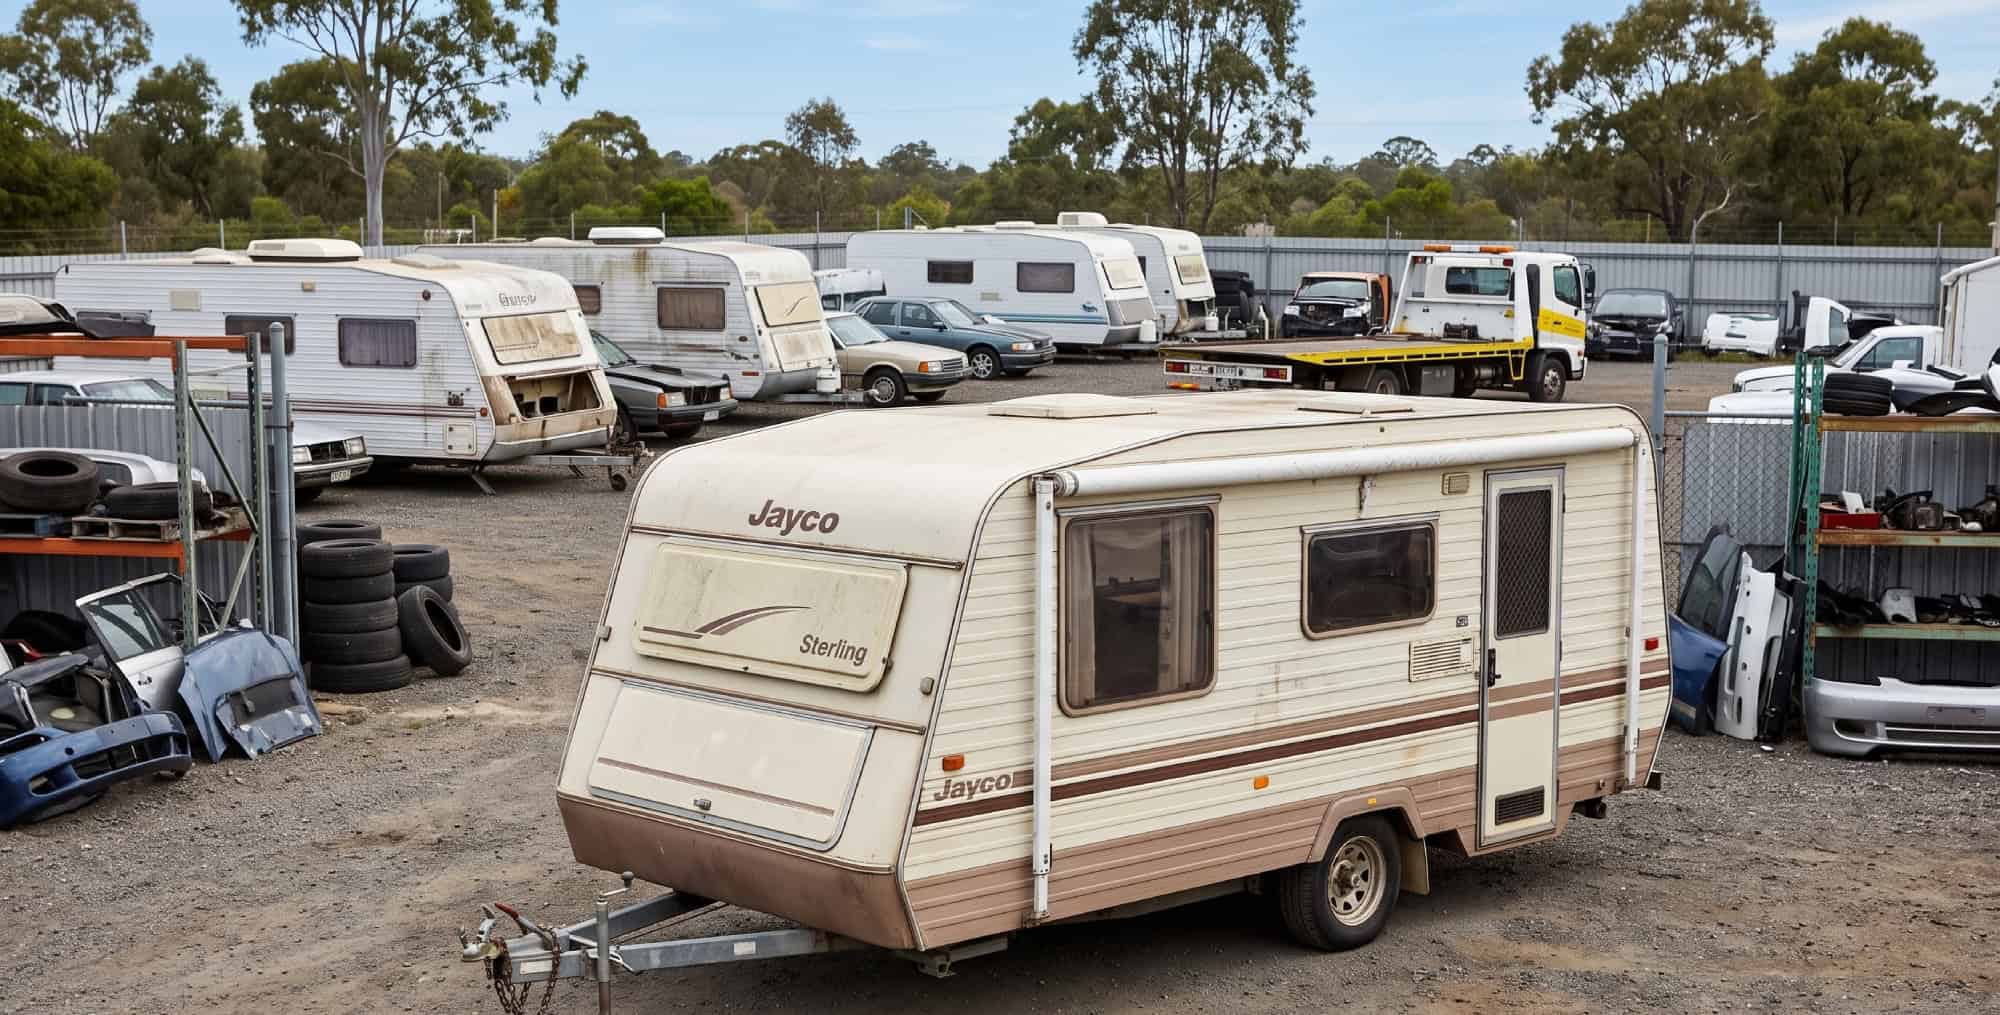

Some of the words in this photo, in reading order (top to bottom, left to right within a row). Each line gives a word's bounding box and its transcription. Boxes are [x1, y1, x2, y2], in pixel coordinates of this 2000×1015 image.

[748, 499, 840, 536] Jayco
[800, 634, 868, 666] Sterling
[934, 774, 1012, 800] Jayco
